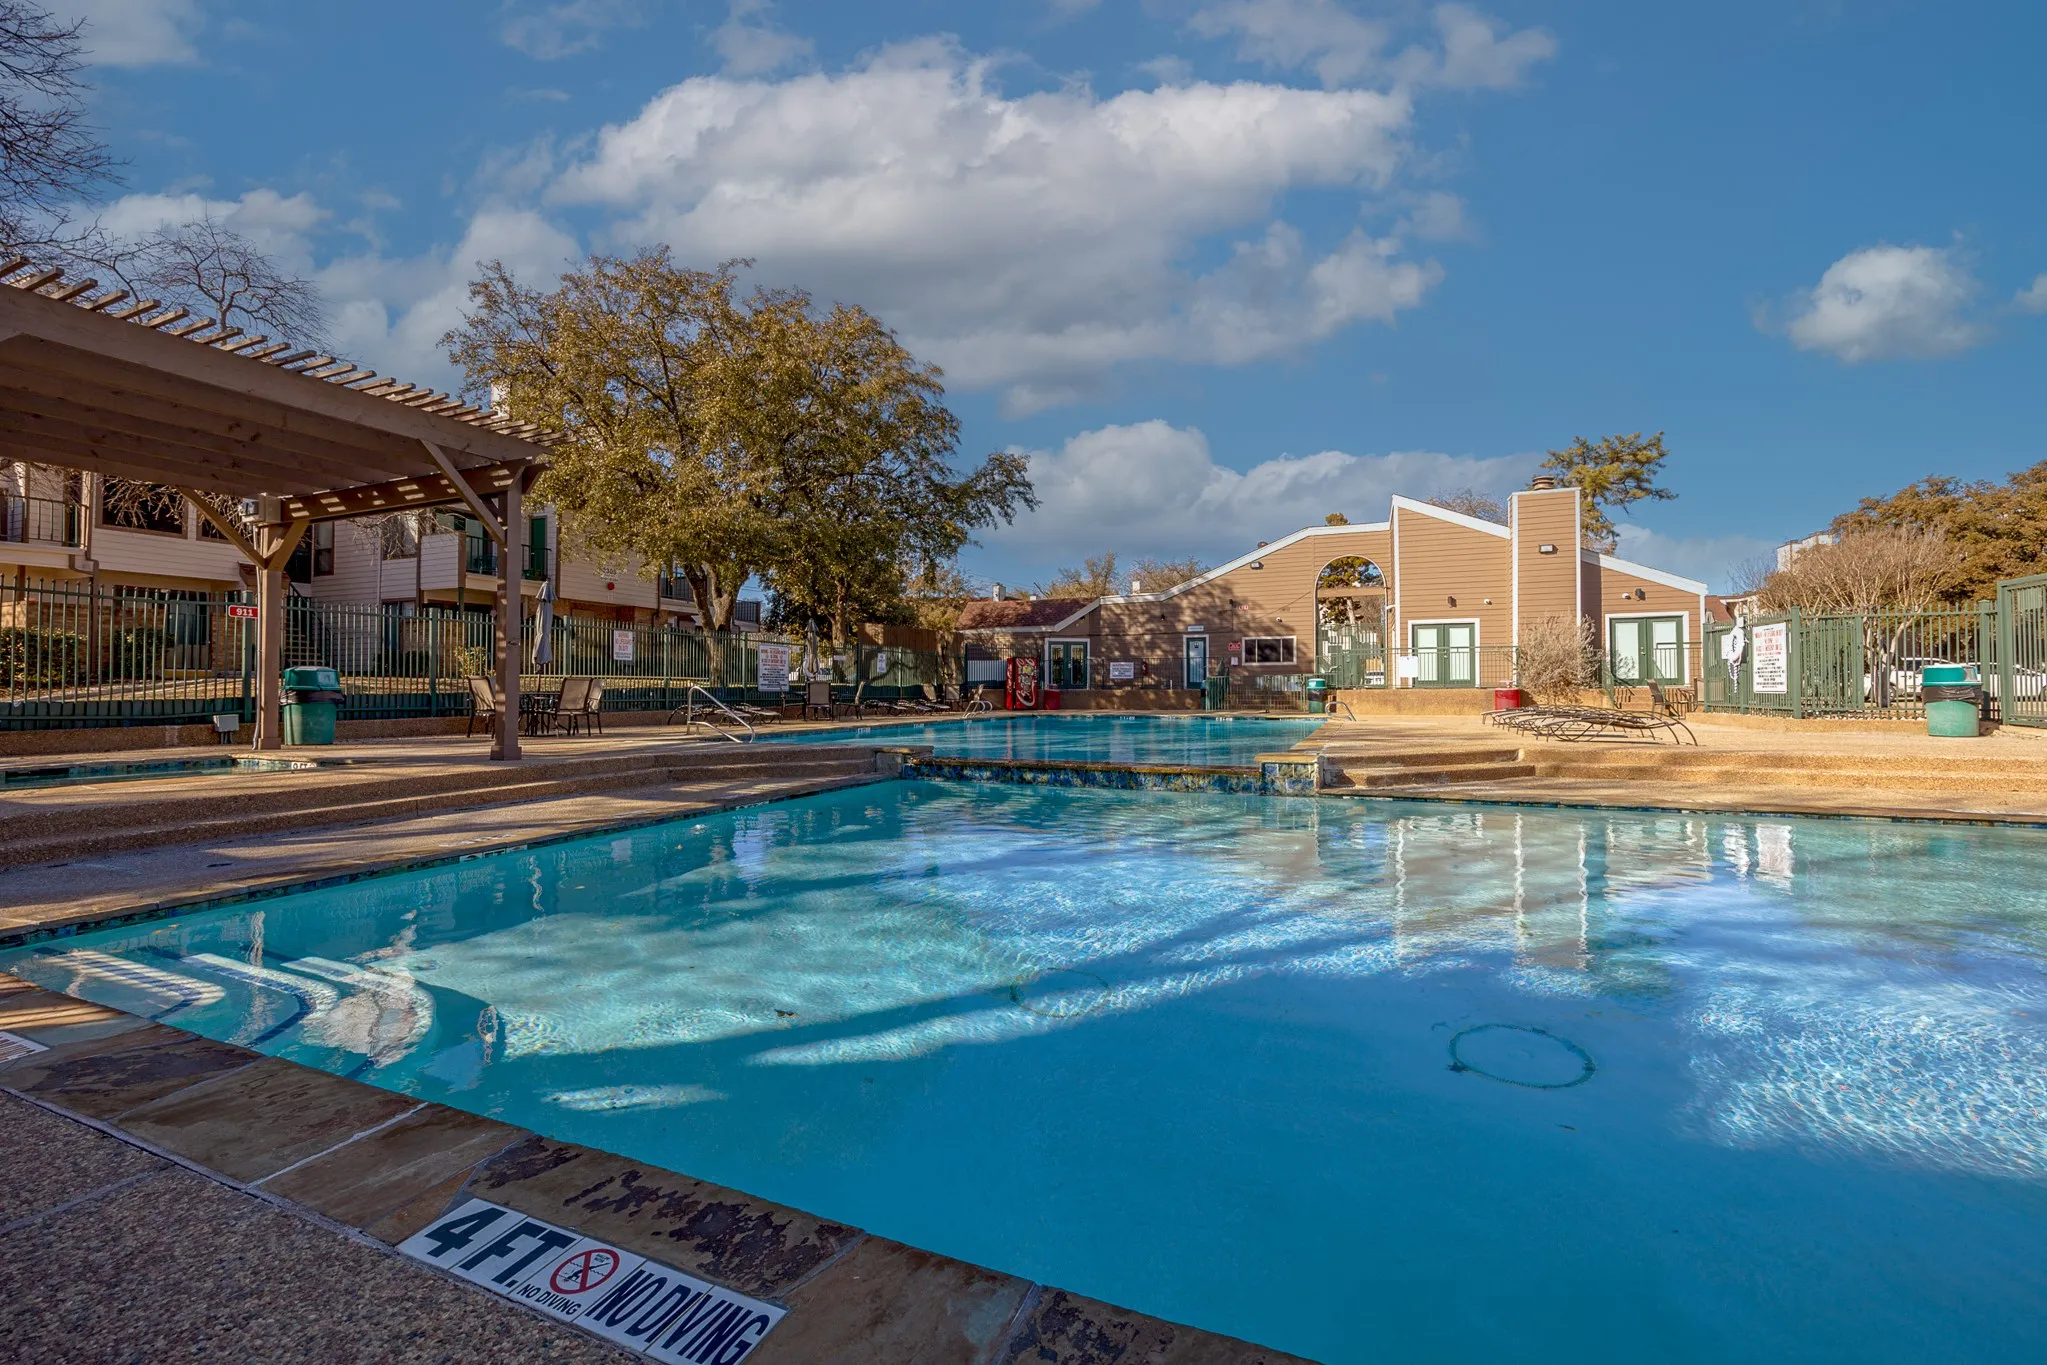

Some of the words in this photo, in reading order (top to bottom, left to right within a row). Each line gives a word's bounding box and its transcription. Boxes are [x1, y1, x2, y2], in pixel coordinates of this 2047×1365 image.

[236, 608, 253, 616] 911
[424, 1207, 508, 1258] 4
[517, 1284, 541, 1299] NO
[534, 1291, 582, 1315] DIVING
[584, 1269, 668, 1328] NO
[624, 1284, 770, 1365] DIVING
